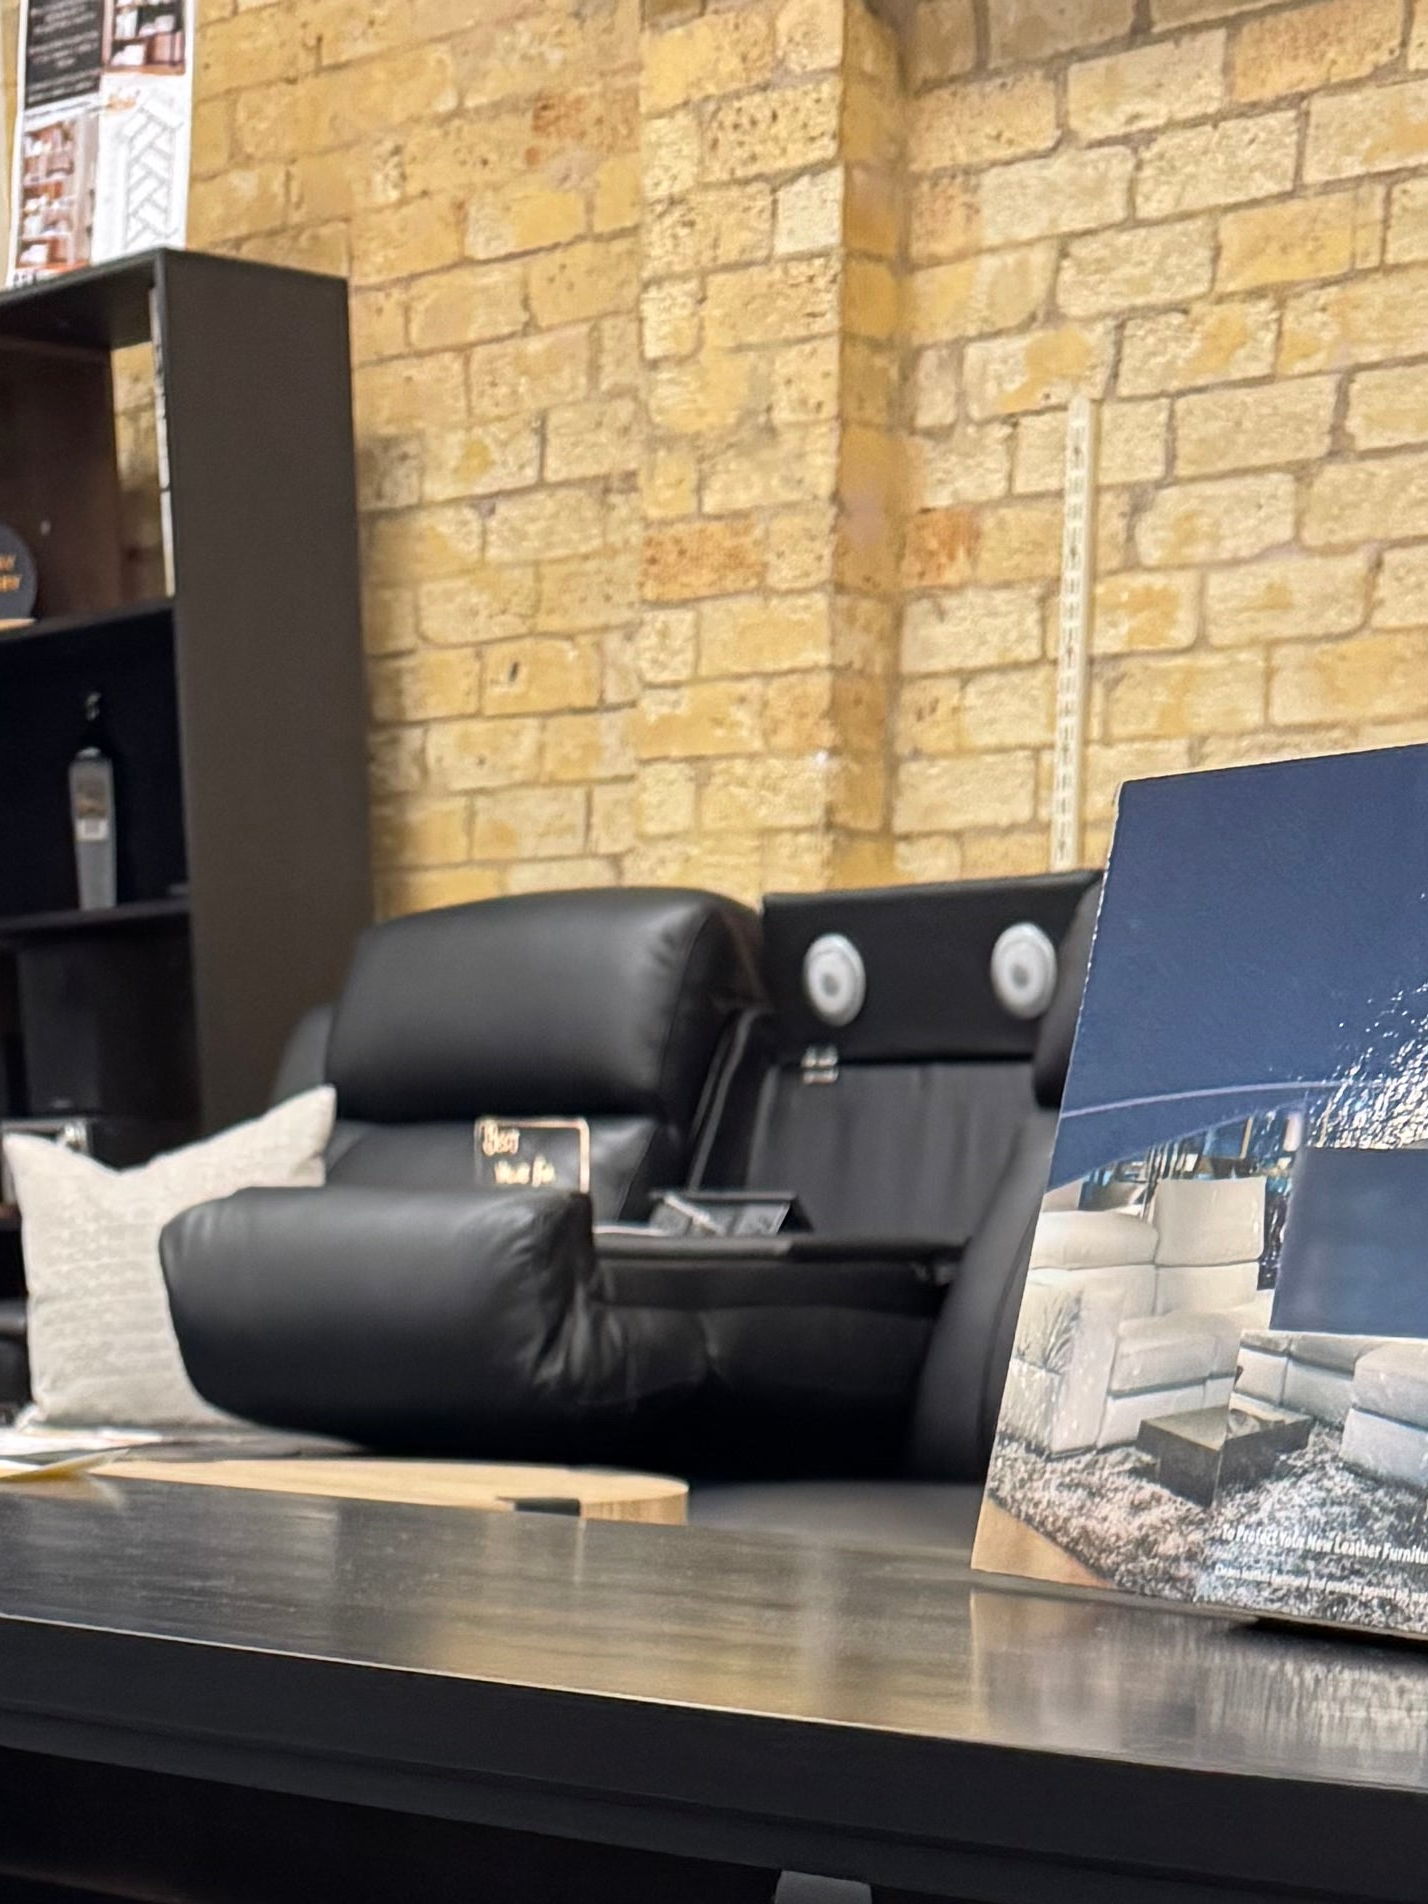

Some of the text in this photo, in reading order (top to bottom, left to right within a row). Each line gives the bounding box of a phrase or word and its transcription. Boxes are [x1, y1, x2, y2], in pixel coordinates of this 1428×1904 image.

[1221, 1524, 1235, 1541] To
[1236, 1523, 1278, 1546] Protect
[1307, 1533, 1333, 1553] New
[1333, 1533, 1382, 1559] Leather
